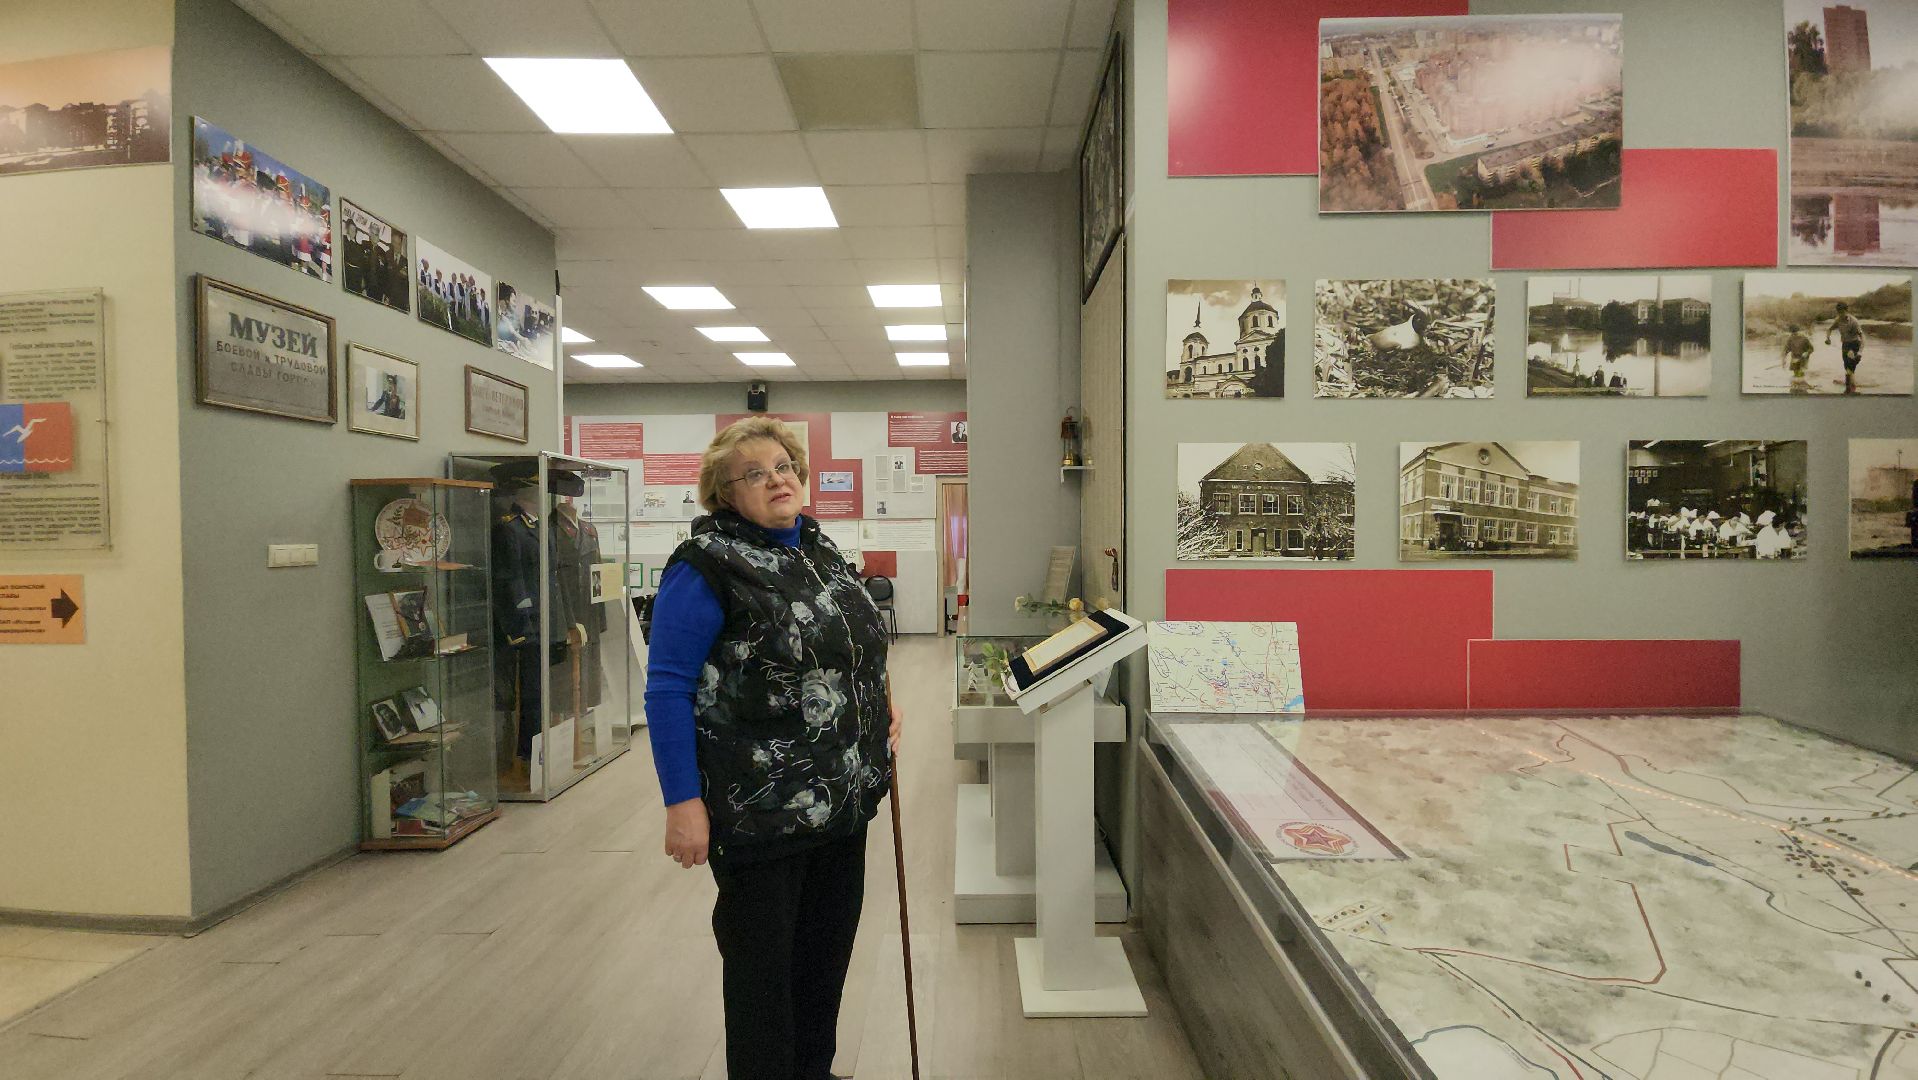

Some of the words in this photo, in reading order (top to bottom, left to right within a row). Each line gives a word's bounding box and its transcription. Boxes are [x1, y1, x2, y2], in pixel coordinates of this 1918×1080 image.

[229, 311, 318, 358] МУЗЕЙ
[216, 340, 260, 361] БОЕВОЙ
[274, 354, 326, 375] ТРУДОВОЙ
